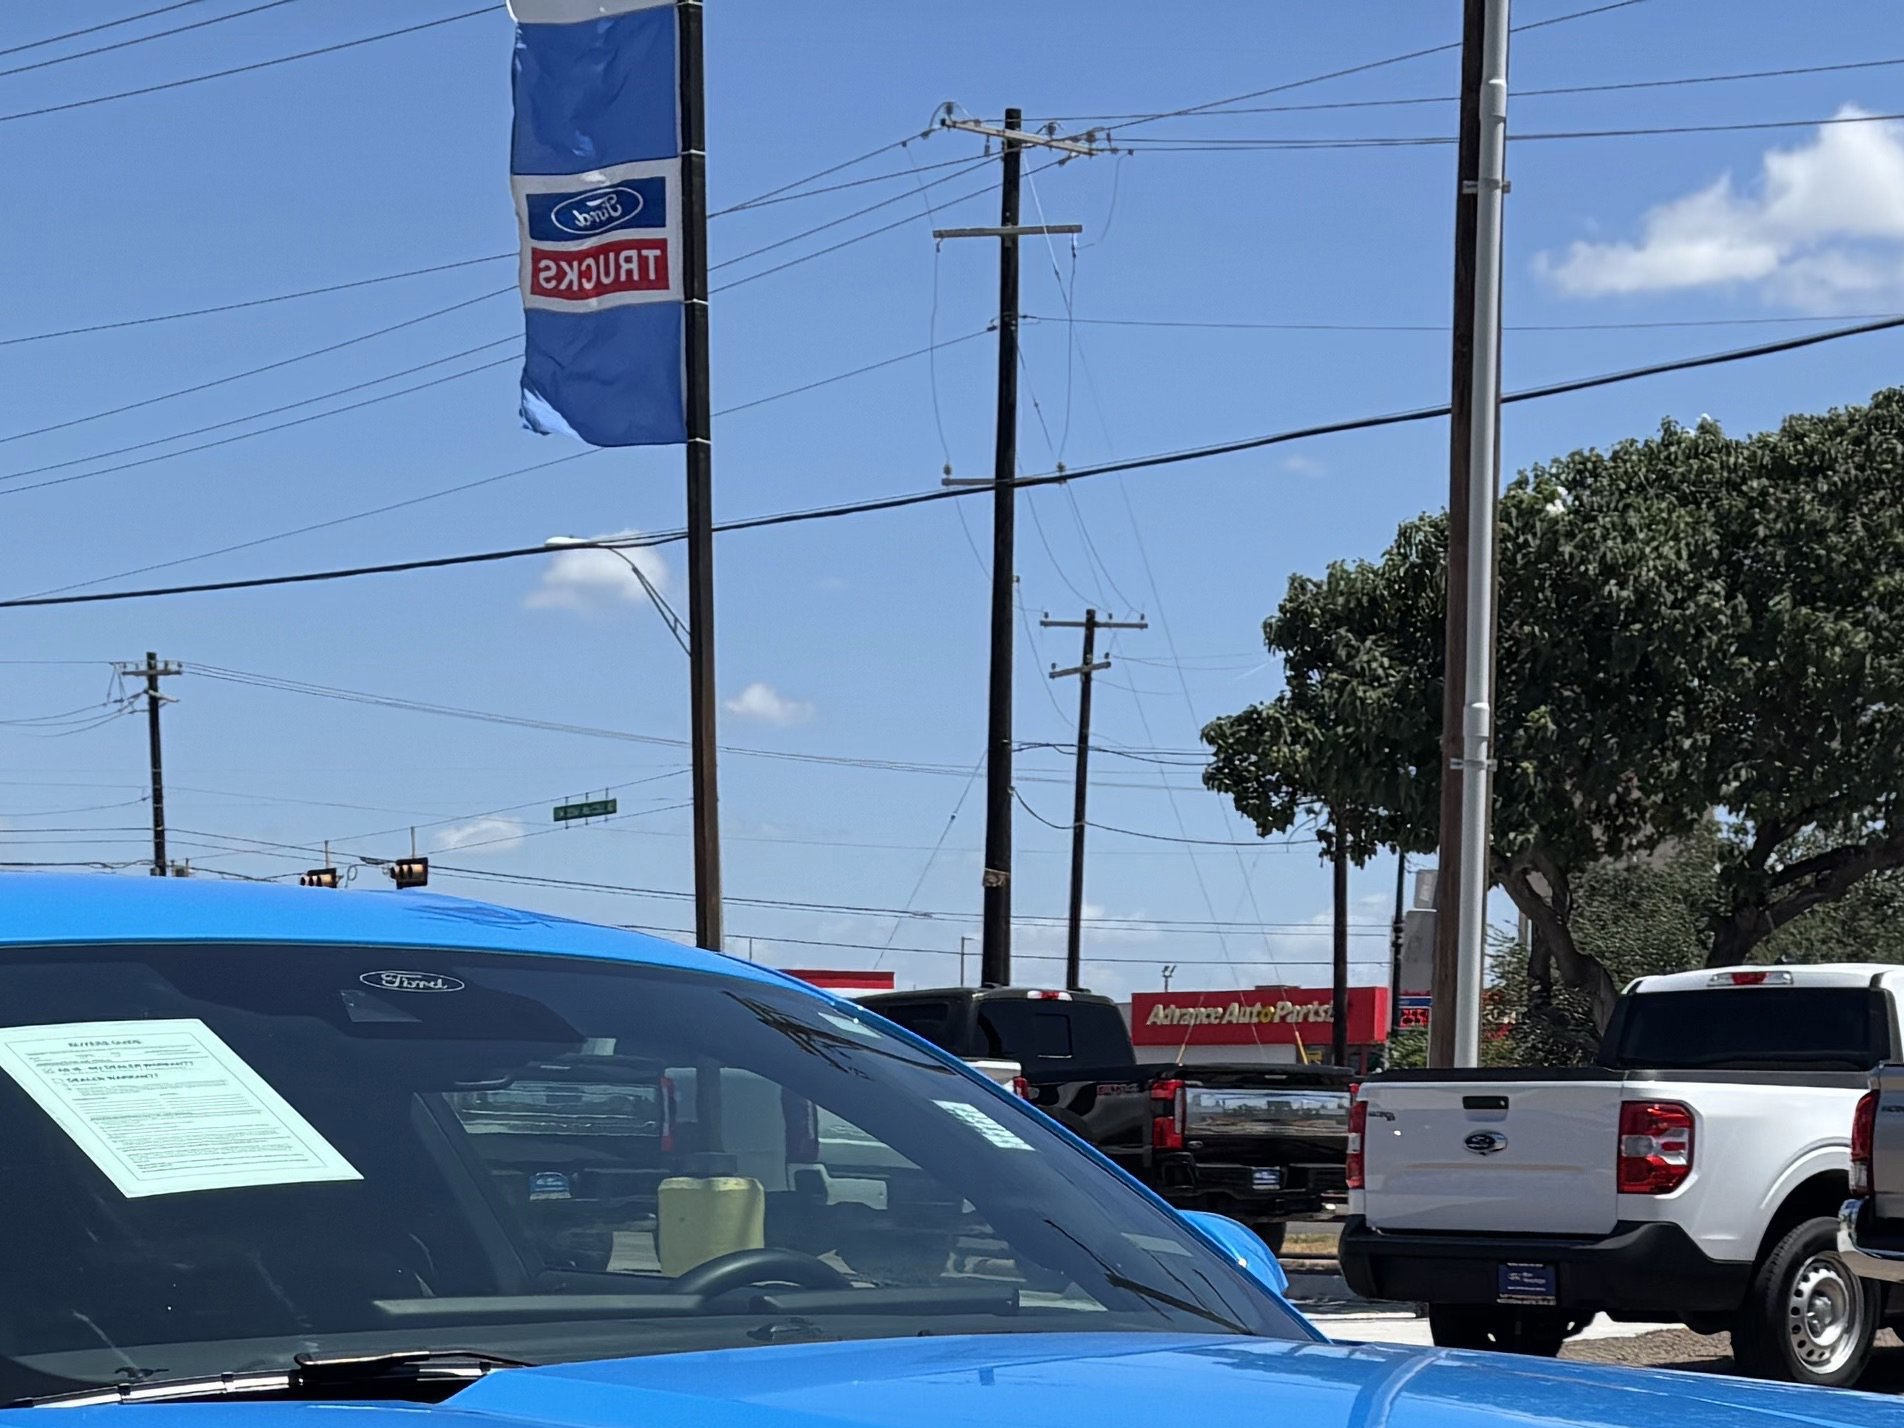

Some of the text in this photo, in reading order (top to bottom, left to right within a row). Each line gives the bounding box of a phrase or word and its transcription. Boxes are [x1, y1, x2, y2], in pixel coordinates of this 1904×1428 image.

[380, 972, 448, 989] Ford
[1146, 1003, 1222, 1025] Advance
[1222, 1002, 1274, 1025] Auto
